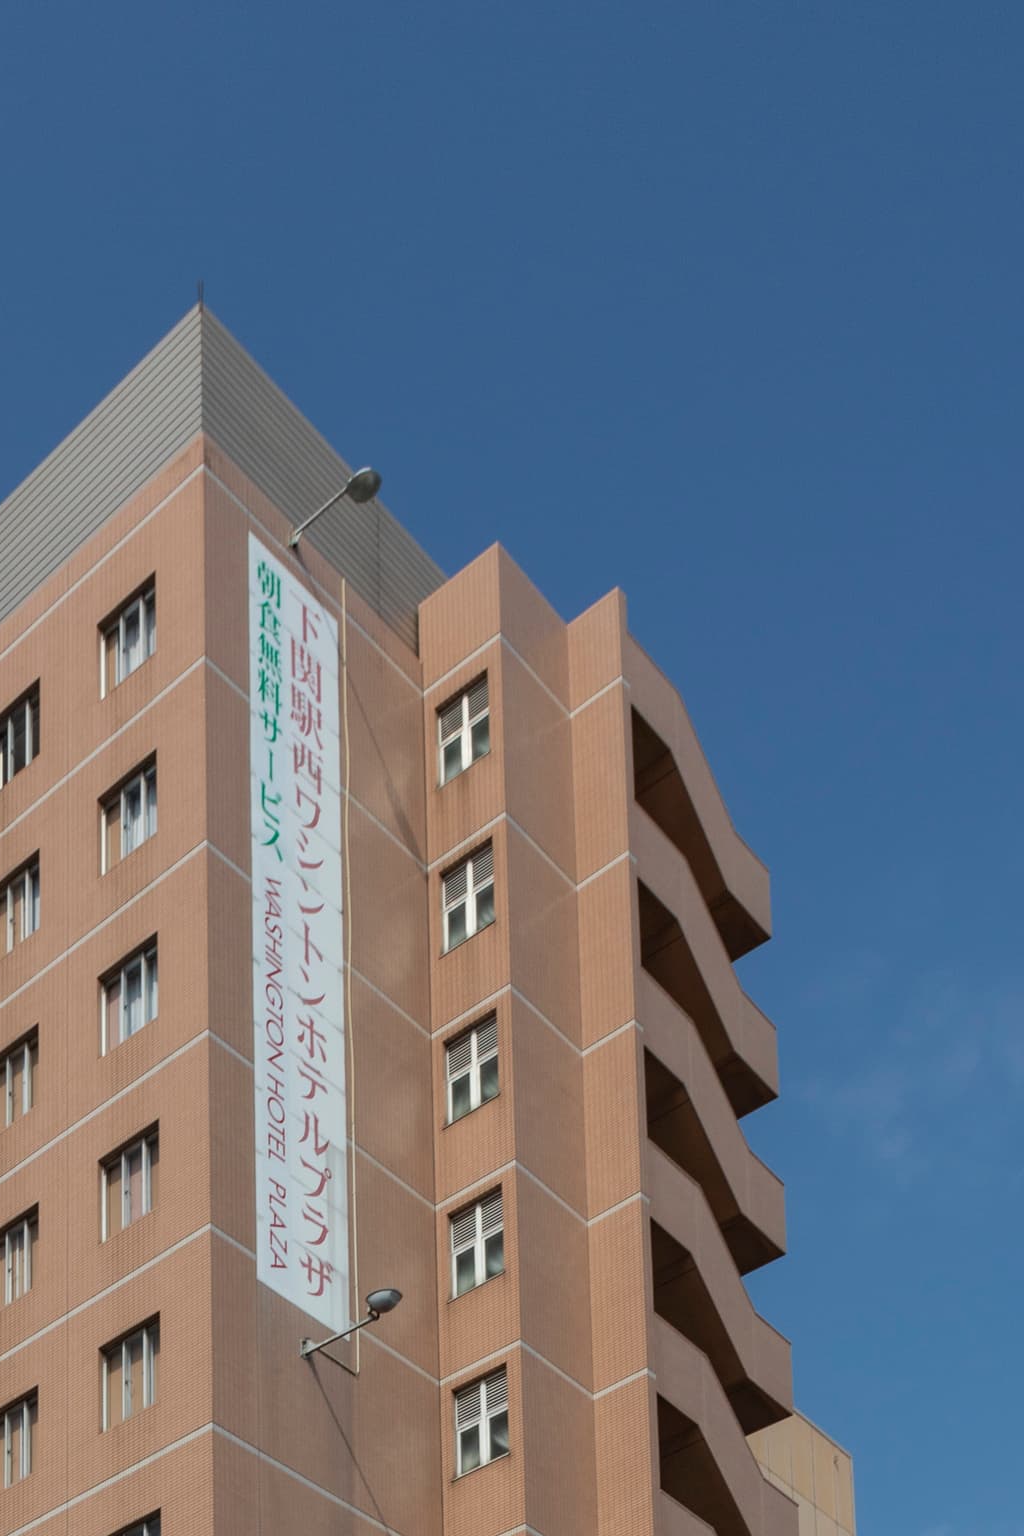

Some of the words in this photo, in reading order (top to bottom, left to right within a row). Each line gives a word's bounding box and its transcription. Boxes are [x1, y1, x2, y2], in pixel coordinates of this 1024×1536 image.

[257, 560, 283, 862] 朝食無料サービス
[265, 877, 284, 1072] WASHINGTON
[289, 589, 334, 1297] 下関駅西ワシントンホテルプラザ
[267, 1072, 286, 1162] HOTEL
[268, 1177, 288, 1269] PLAZA
